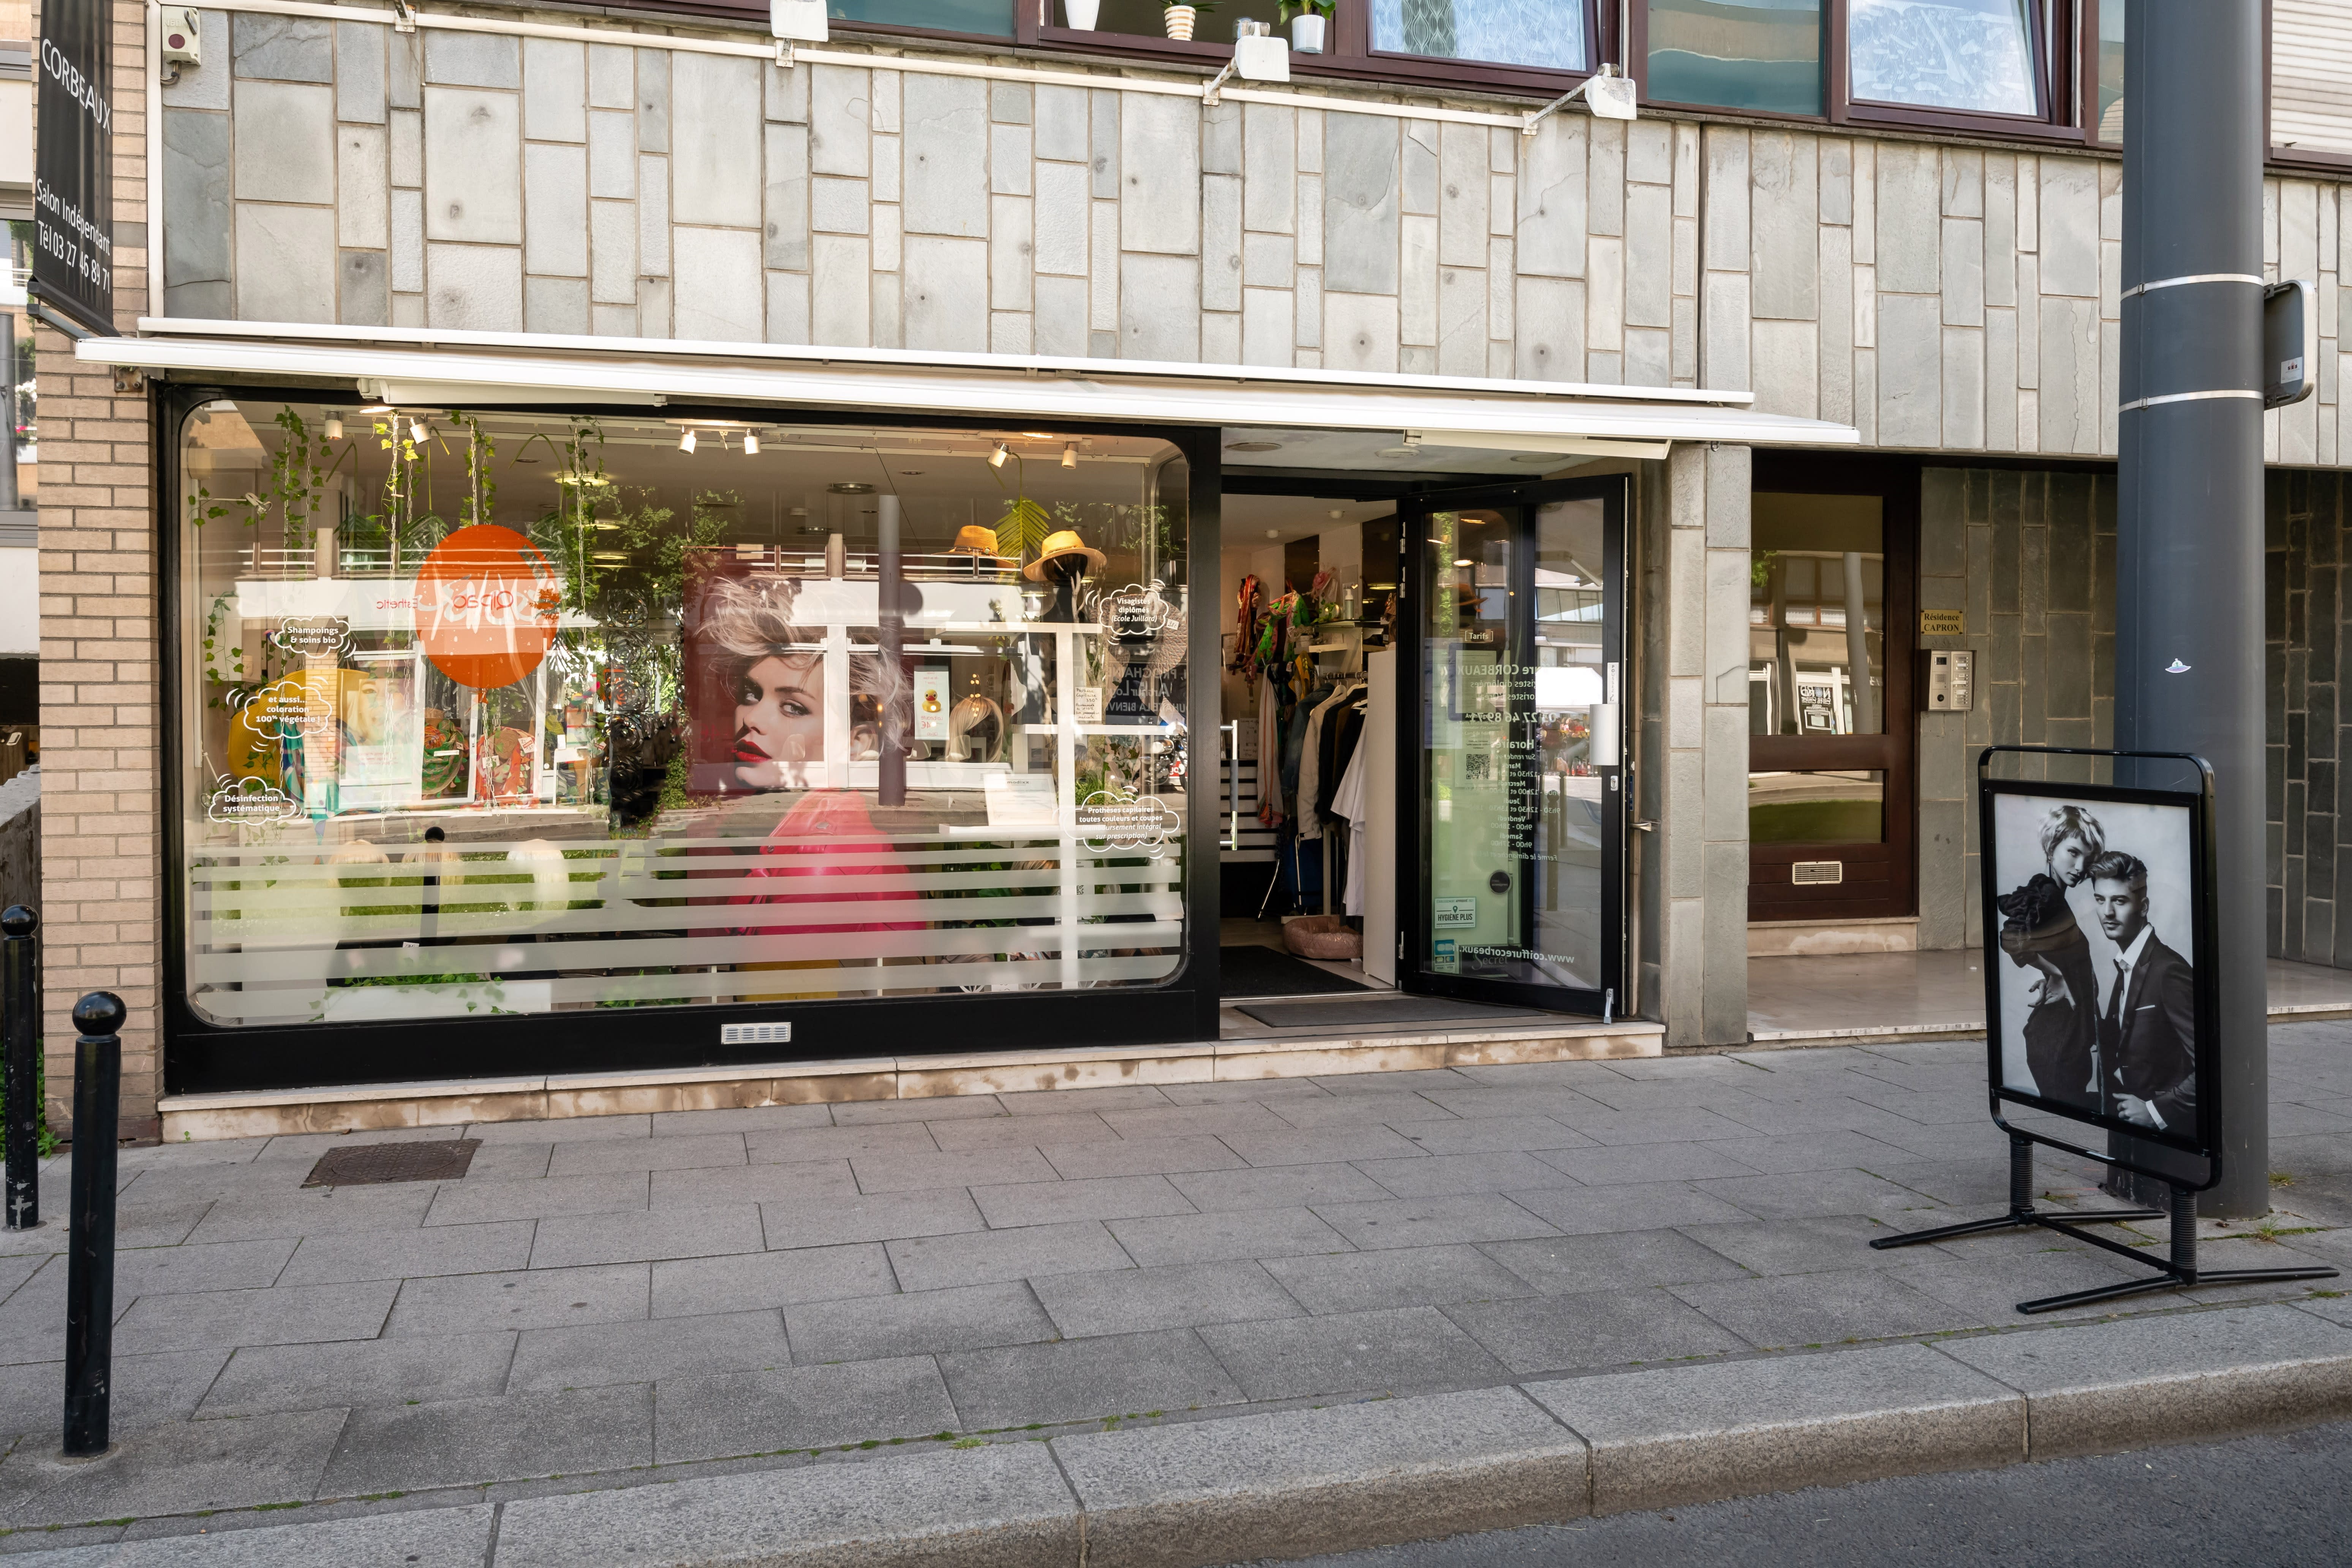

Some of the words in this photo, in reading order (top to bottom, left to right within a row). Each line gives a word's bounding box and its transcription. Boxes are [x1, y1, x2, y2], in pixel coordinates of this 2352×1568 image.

[42, 39, 111, 135] CORBEAUX
[37, 178, 59, 215] Salon
[63, 198, 110, 256] Indépendant
[38, 220, 52, 251] Tél
[53, 232, 64, 259] 03
[66, 241, 76, 267] 27
[80, 251, 89, 278] 46
[92, 259, 100, 286] 89
[103, 267, 109, 294] 71
[288, 626, 339, 635] Shampoings
[280, 715, 315, 724] végétale
[223, 805, 280, 813] systématique
[1107, 831, 1148, 840] prescription)
[1438, 913, 1459, 921] HYGIÈNE
[1472, 954, 1509, 970] Secret
